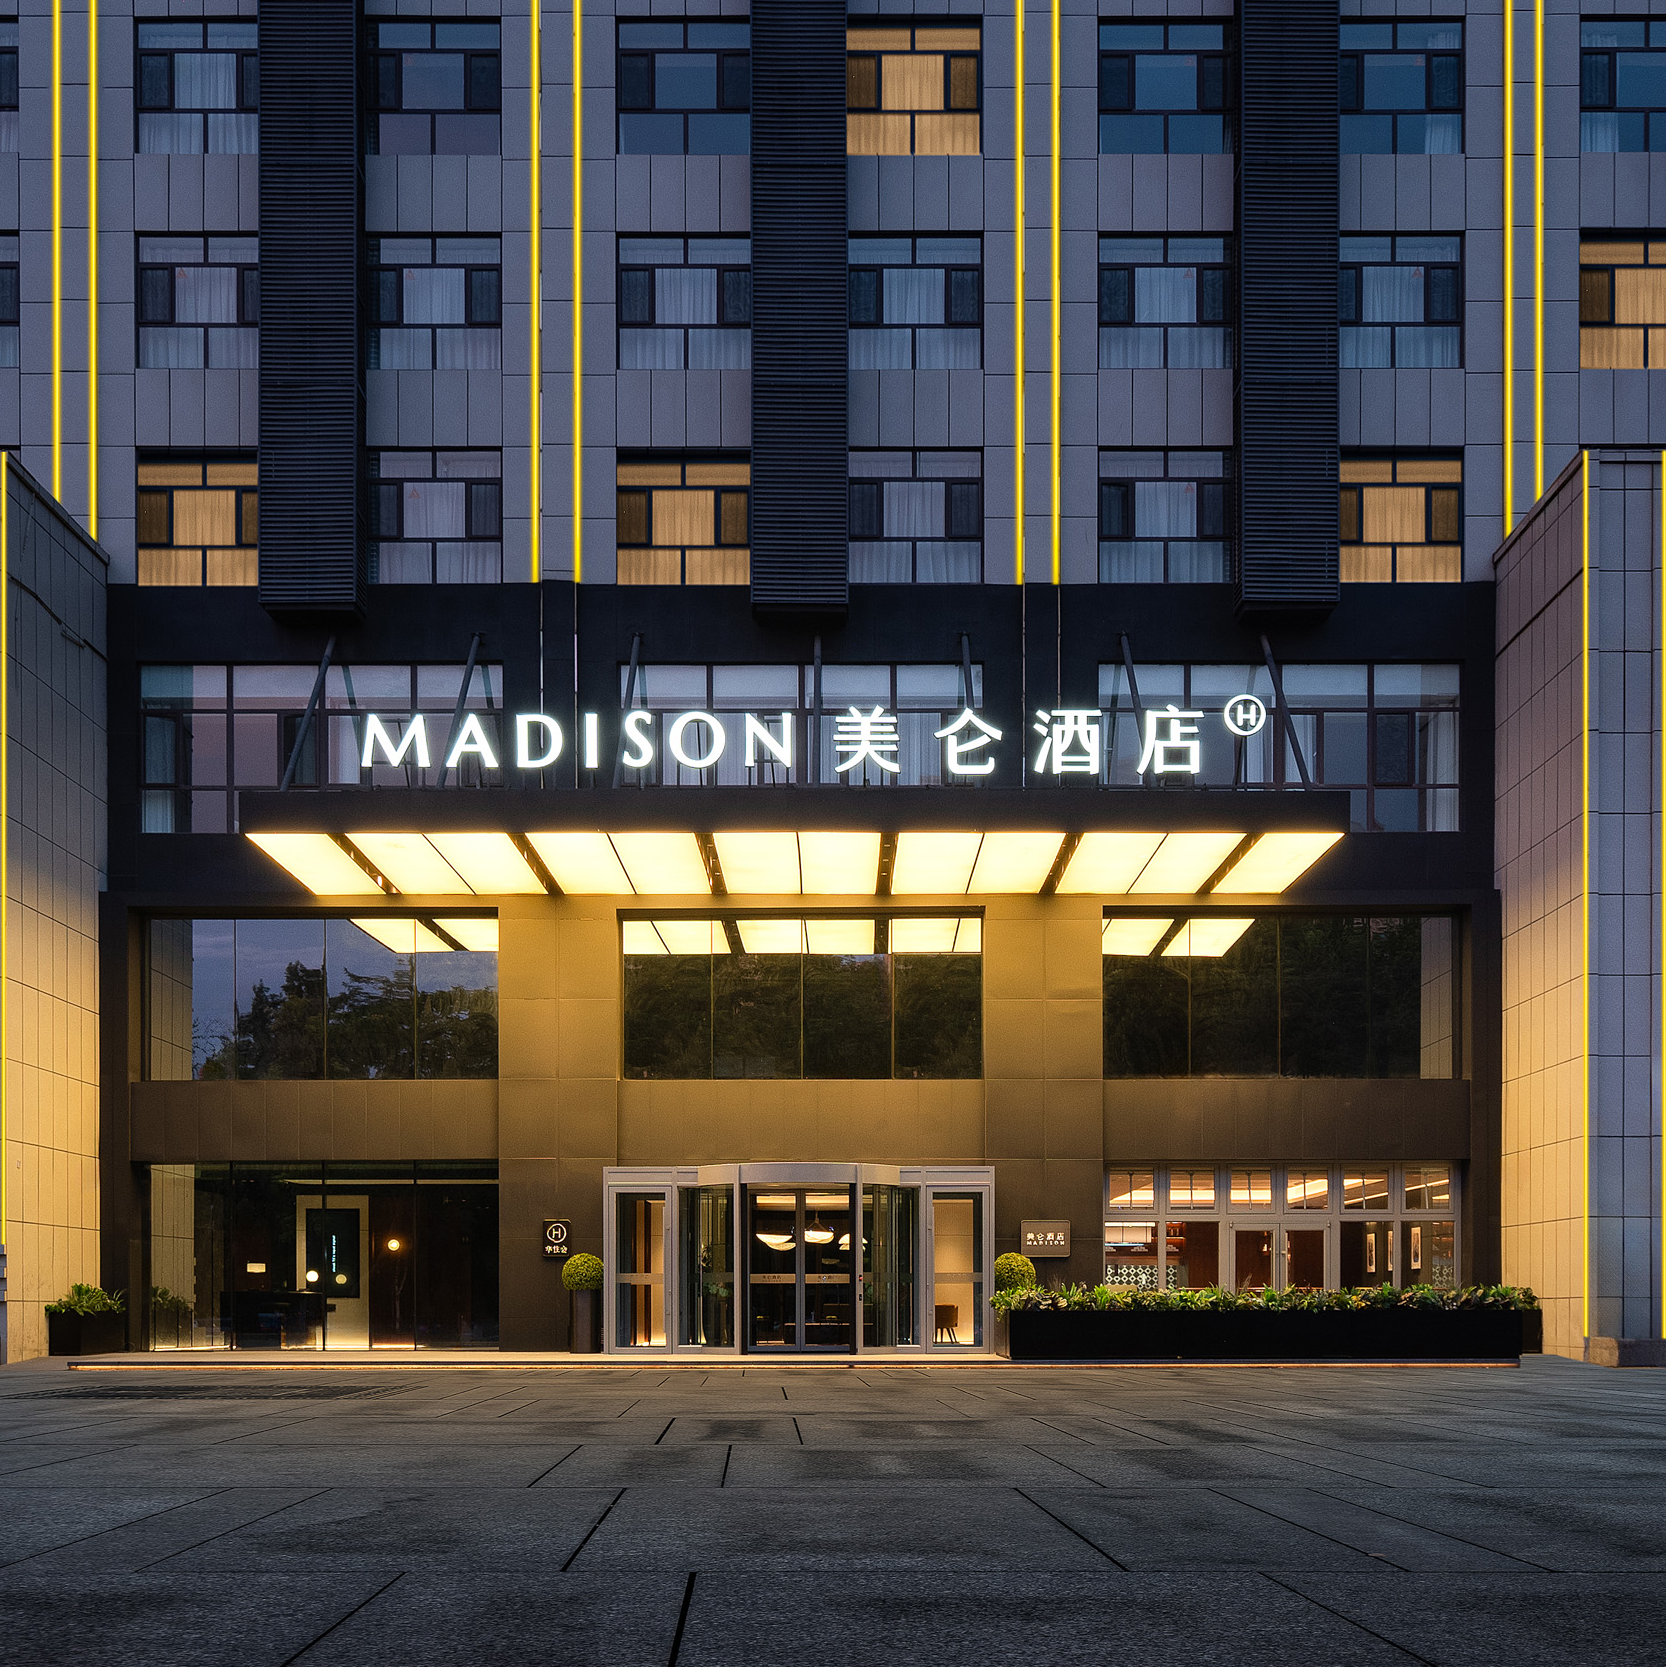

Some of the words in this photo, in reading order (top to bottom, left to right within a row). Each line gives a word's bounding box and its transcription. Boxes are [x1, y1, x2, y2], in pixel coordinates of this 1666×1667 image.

[360, 710, 793, 770] MADISON
[833, 703, 1206, 776] 美仑酒店
